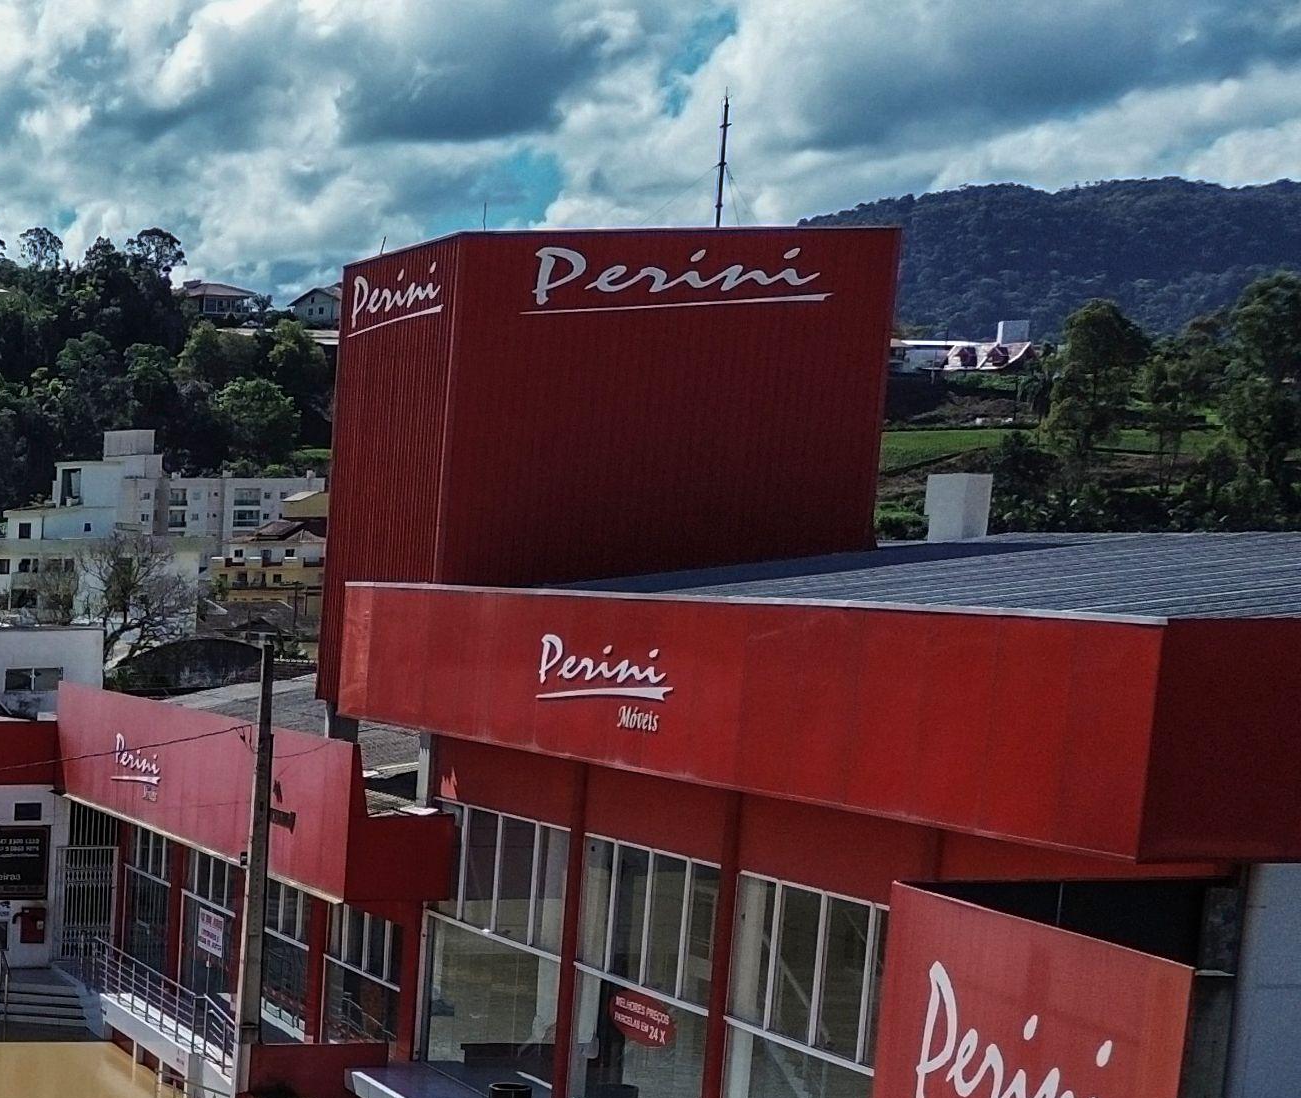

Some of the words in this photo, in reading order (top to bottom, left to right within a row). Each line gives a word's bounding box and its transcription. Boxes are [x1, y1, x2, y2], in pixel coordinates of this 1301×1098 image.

[352, 261, 441, 327] Perini
[532, 246, 821, 304] Perini
[539, 633, 667, 685] Perini
[617, 704, 659, 732] Móveis
[115, 733, 160, 774] Perini
[614, 995, 645, 1015] MELHORES
[645, 1007, 670, 1025] PREÇOS
[614, 1011, 641, 1030] PARCELAS
[640, 1021, 649, 1033] EM
[648, 1025, 659, 1041] 24
[659, 1030, 667, 1045] X
